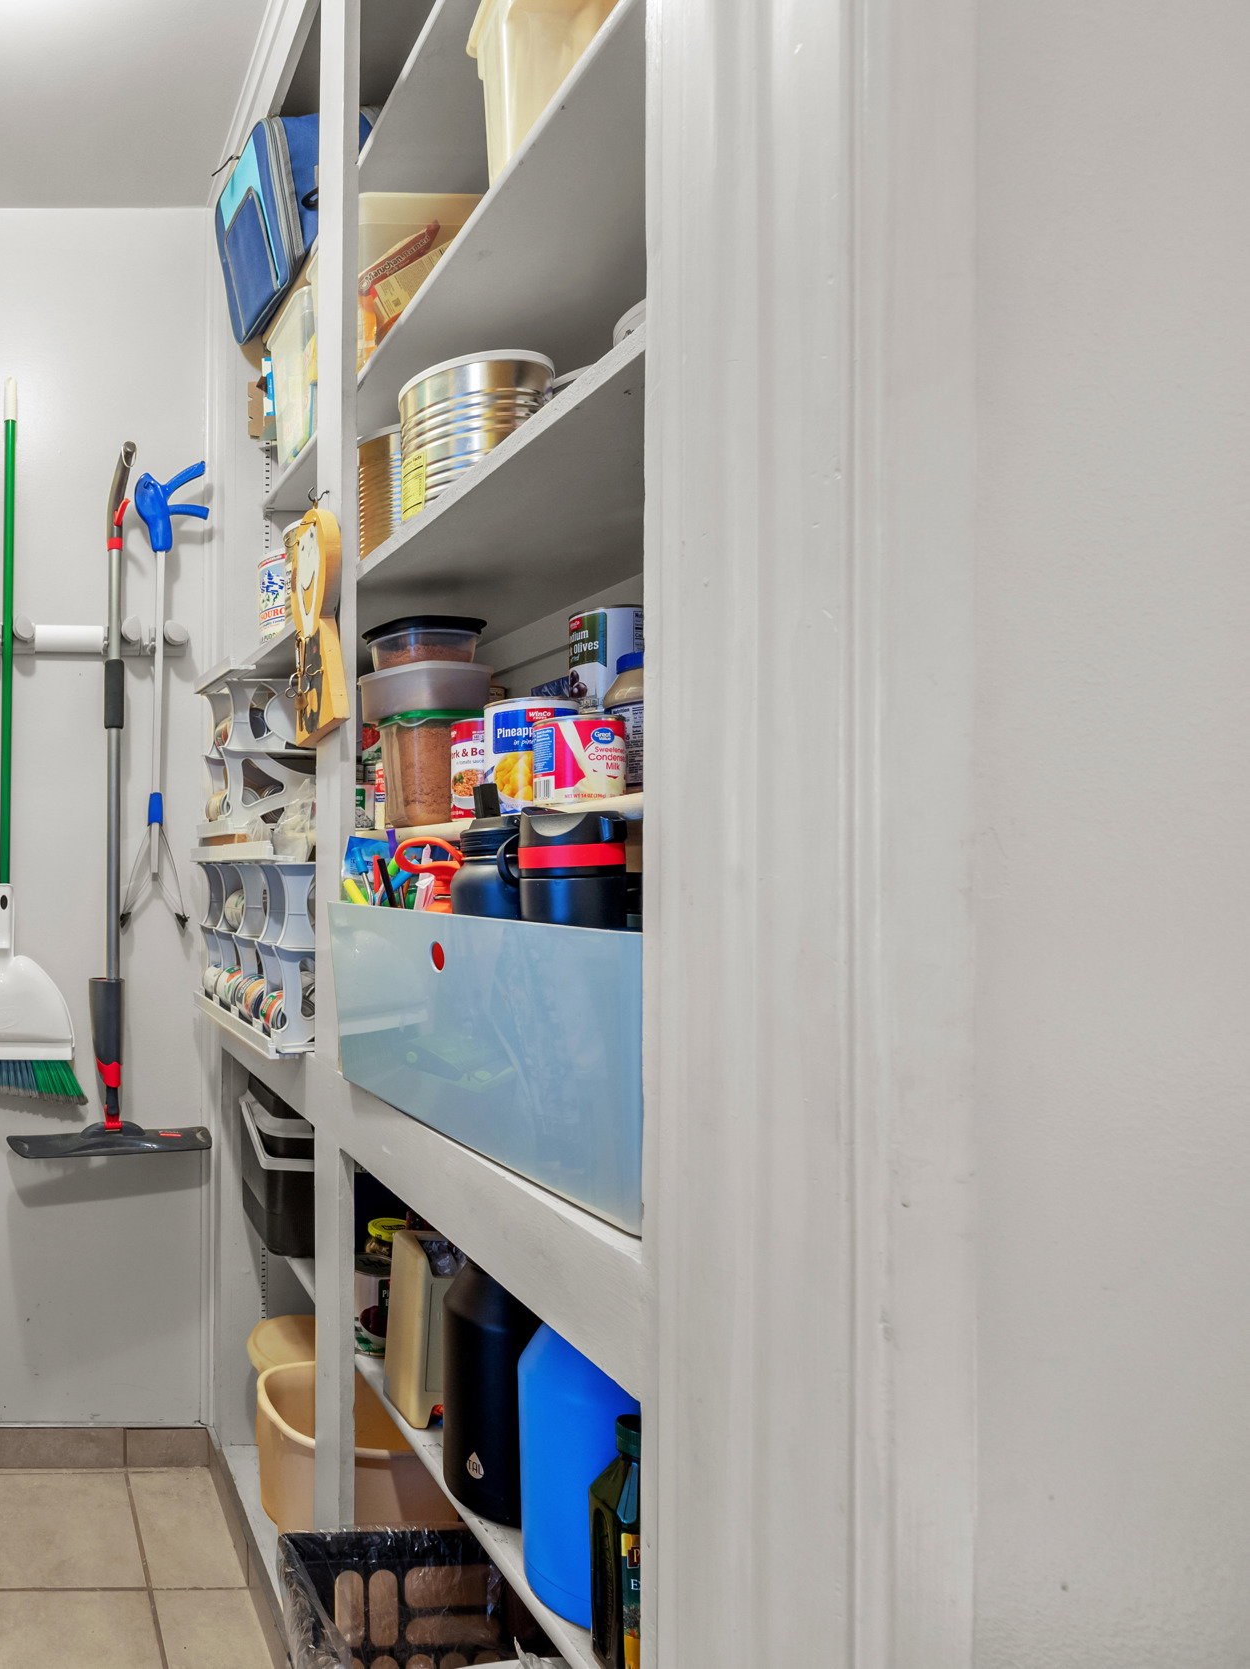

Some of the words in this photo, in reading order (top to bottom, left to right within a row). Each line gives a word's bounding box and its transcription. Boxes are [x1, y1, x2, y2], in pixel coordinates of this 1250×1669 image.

[365, 255, 403, 282] Maruchan
[403, 234, 431, 259] Ramen
[573, 640, 600, 654] Olives
[528, 710, 552, 718] WinCo
[496, 727, 533, 739] Pineapp
[461, 748, 470, 757] &
[605, 761, 621, 771] Milk
[468, 1459, 484, 1476] TAL
